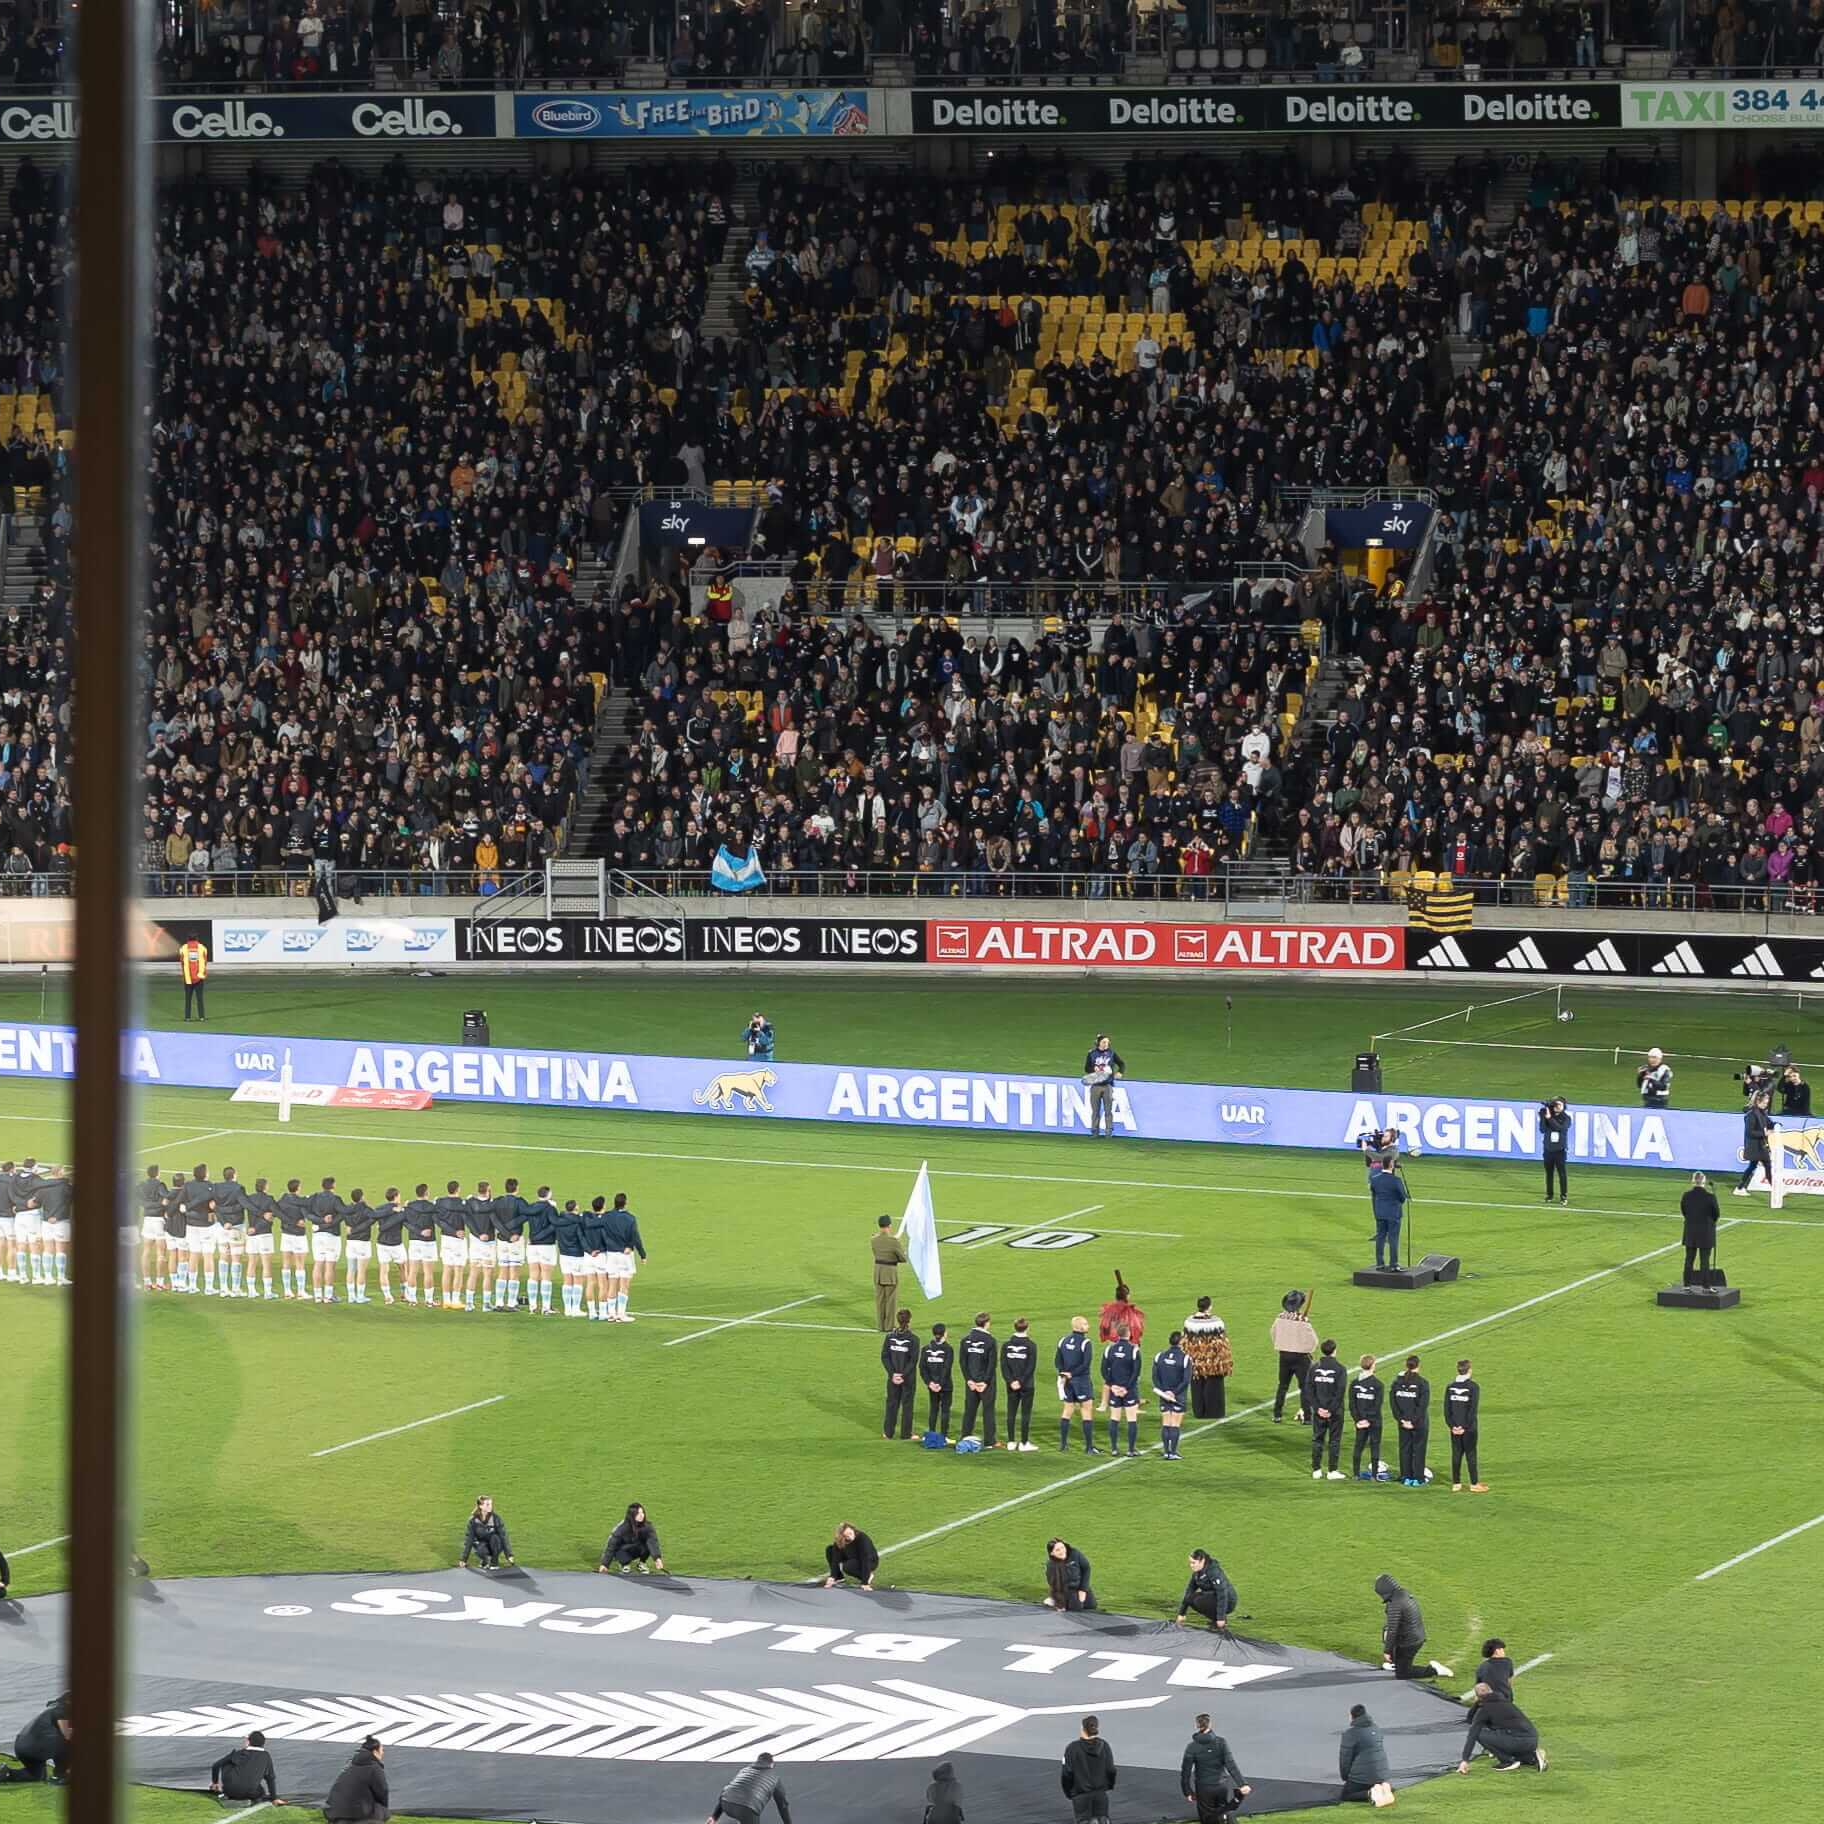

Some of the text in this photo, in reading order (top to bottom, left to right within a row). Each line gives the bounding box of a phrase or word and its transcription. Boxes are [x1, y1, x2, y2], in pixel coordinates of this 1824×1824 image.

[542, 109, 592, 122] Bluebird
[636, 98, 690, 130] FREE
[932, 98, 1068, 127] Deloitte.
[1108, 97, 1244, 126] Deloitte.
[1286, 95, 1422, 123] Deloitte.
[1464, 92, 1600, 121] Deloitte.
[1630, 90, 1725, 122] TAXI
[1732, 88, 1790, 111] 384
[0, 102, 74, 140] Cell
[660, 514, 691, 533] sky
[1381, 515, 1413, 535] sky
[224, 931, 264, 947] SAP
[283, 931, 323, 947] SAP
[347, 931, 384, 947] SAP
[466, 926, 564, 953] INEOS
[583, 926, 683, 953] INEOS
[702, 926, 801, 953] INEOS
[820, 927, 918, 954] INEOS
[976, 926, 1156, 961] ALTRAD
[1212, 930, 1395, 965] ALTRAD
[1177, 951, 1204, 959] ALTRAD
[234, 1052, 275, 1072] UAR
[345, 1047, 642, 1105] ARGENTINA
[827, 1072, 1148, 1134] ARGENTINA
[1220, 1104, 1266, 1124] UAR
[1344, 1100, 1675, 1162] ARGENINA
[938, 1226, 1101, 1250] 10
[330, 1588, 1294, 1691] ALL BLACKS
